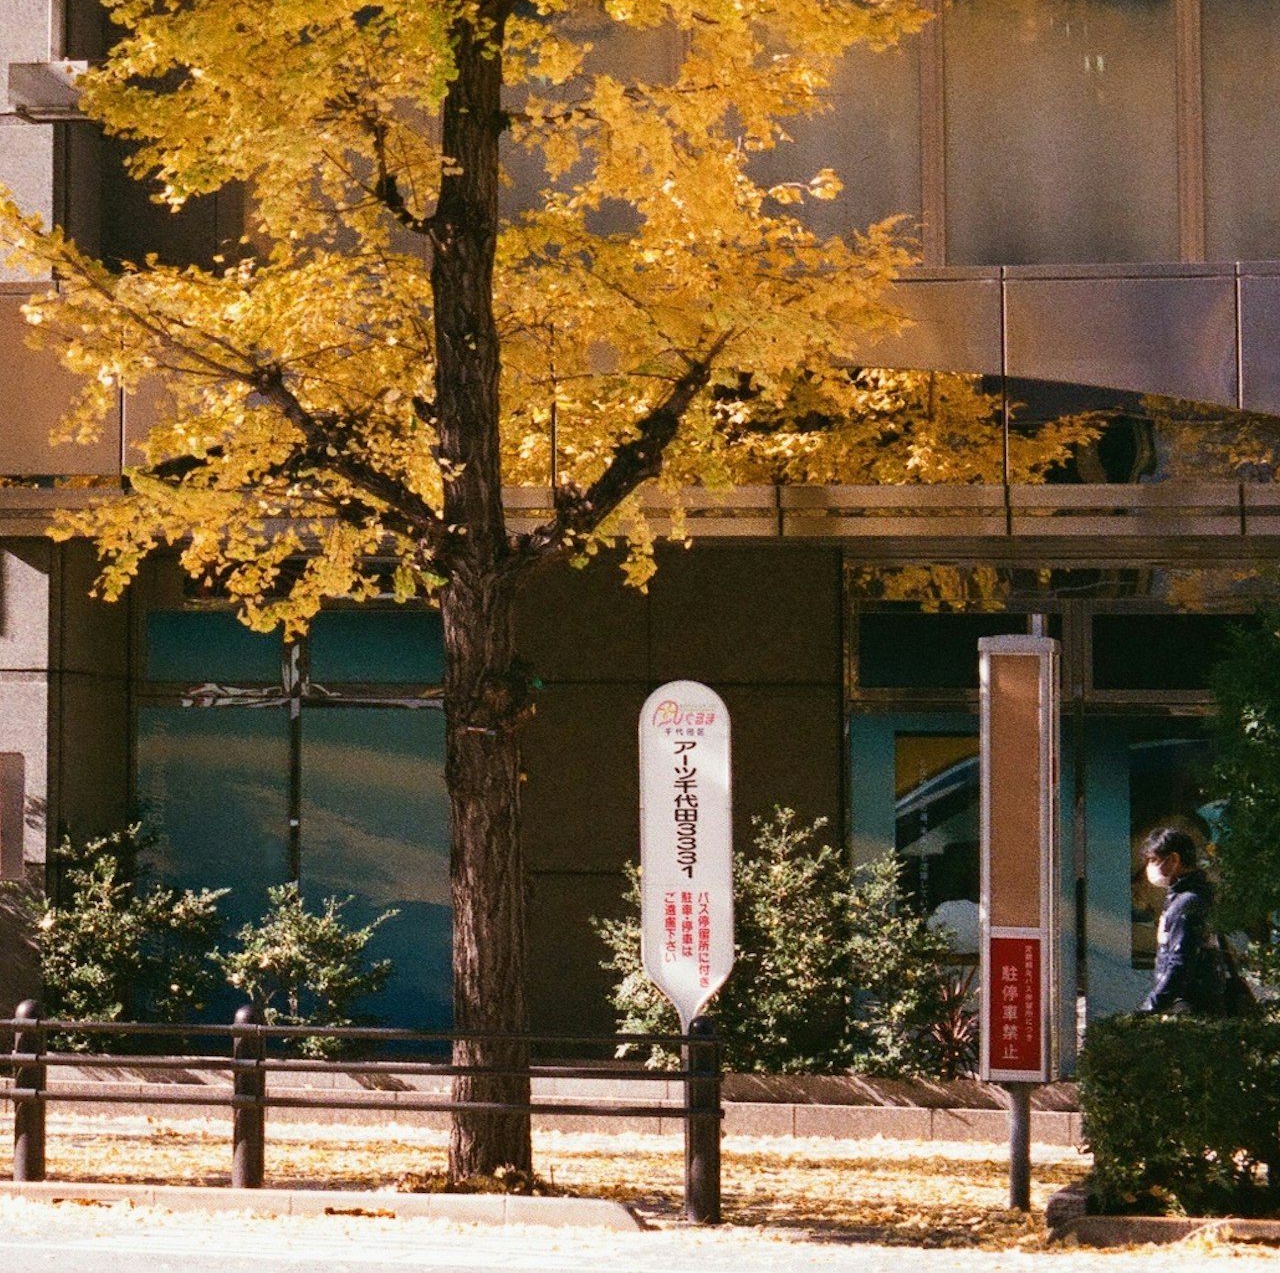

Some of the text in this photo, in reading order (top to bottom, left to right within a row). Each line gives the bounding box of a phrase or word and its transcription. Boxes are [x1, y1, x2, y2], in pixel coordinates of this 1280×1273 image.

[664, 728, 705, 736] 千代田区
[673, 740, 698, 879] アーツ千代田3331
[664, 892, 676, 963] ご遠慮下さい
[681, 892, 693, 958] 駐車・停車は
[698, 892, 711, 987] バス停留所に付き
[1001, 965, 1019, 1059] 駐停車禁止
